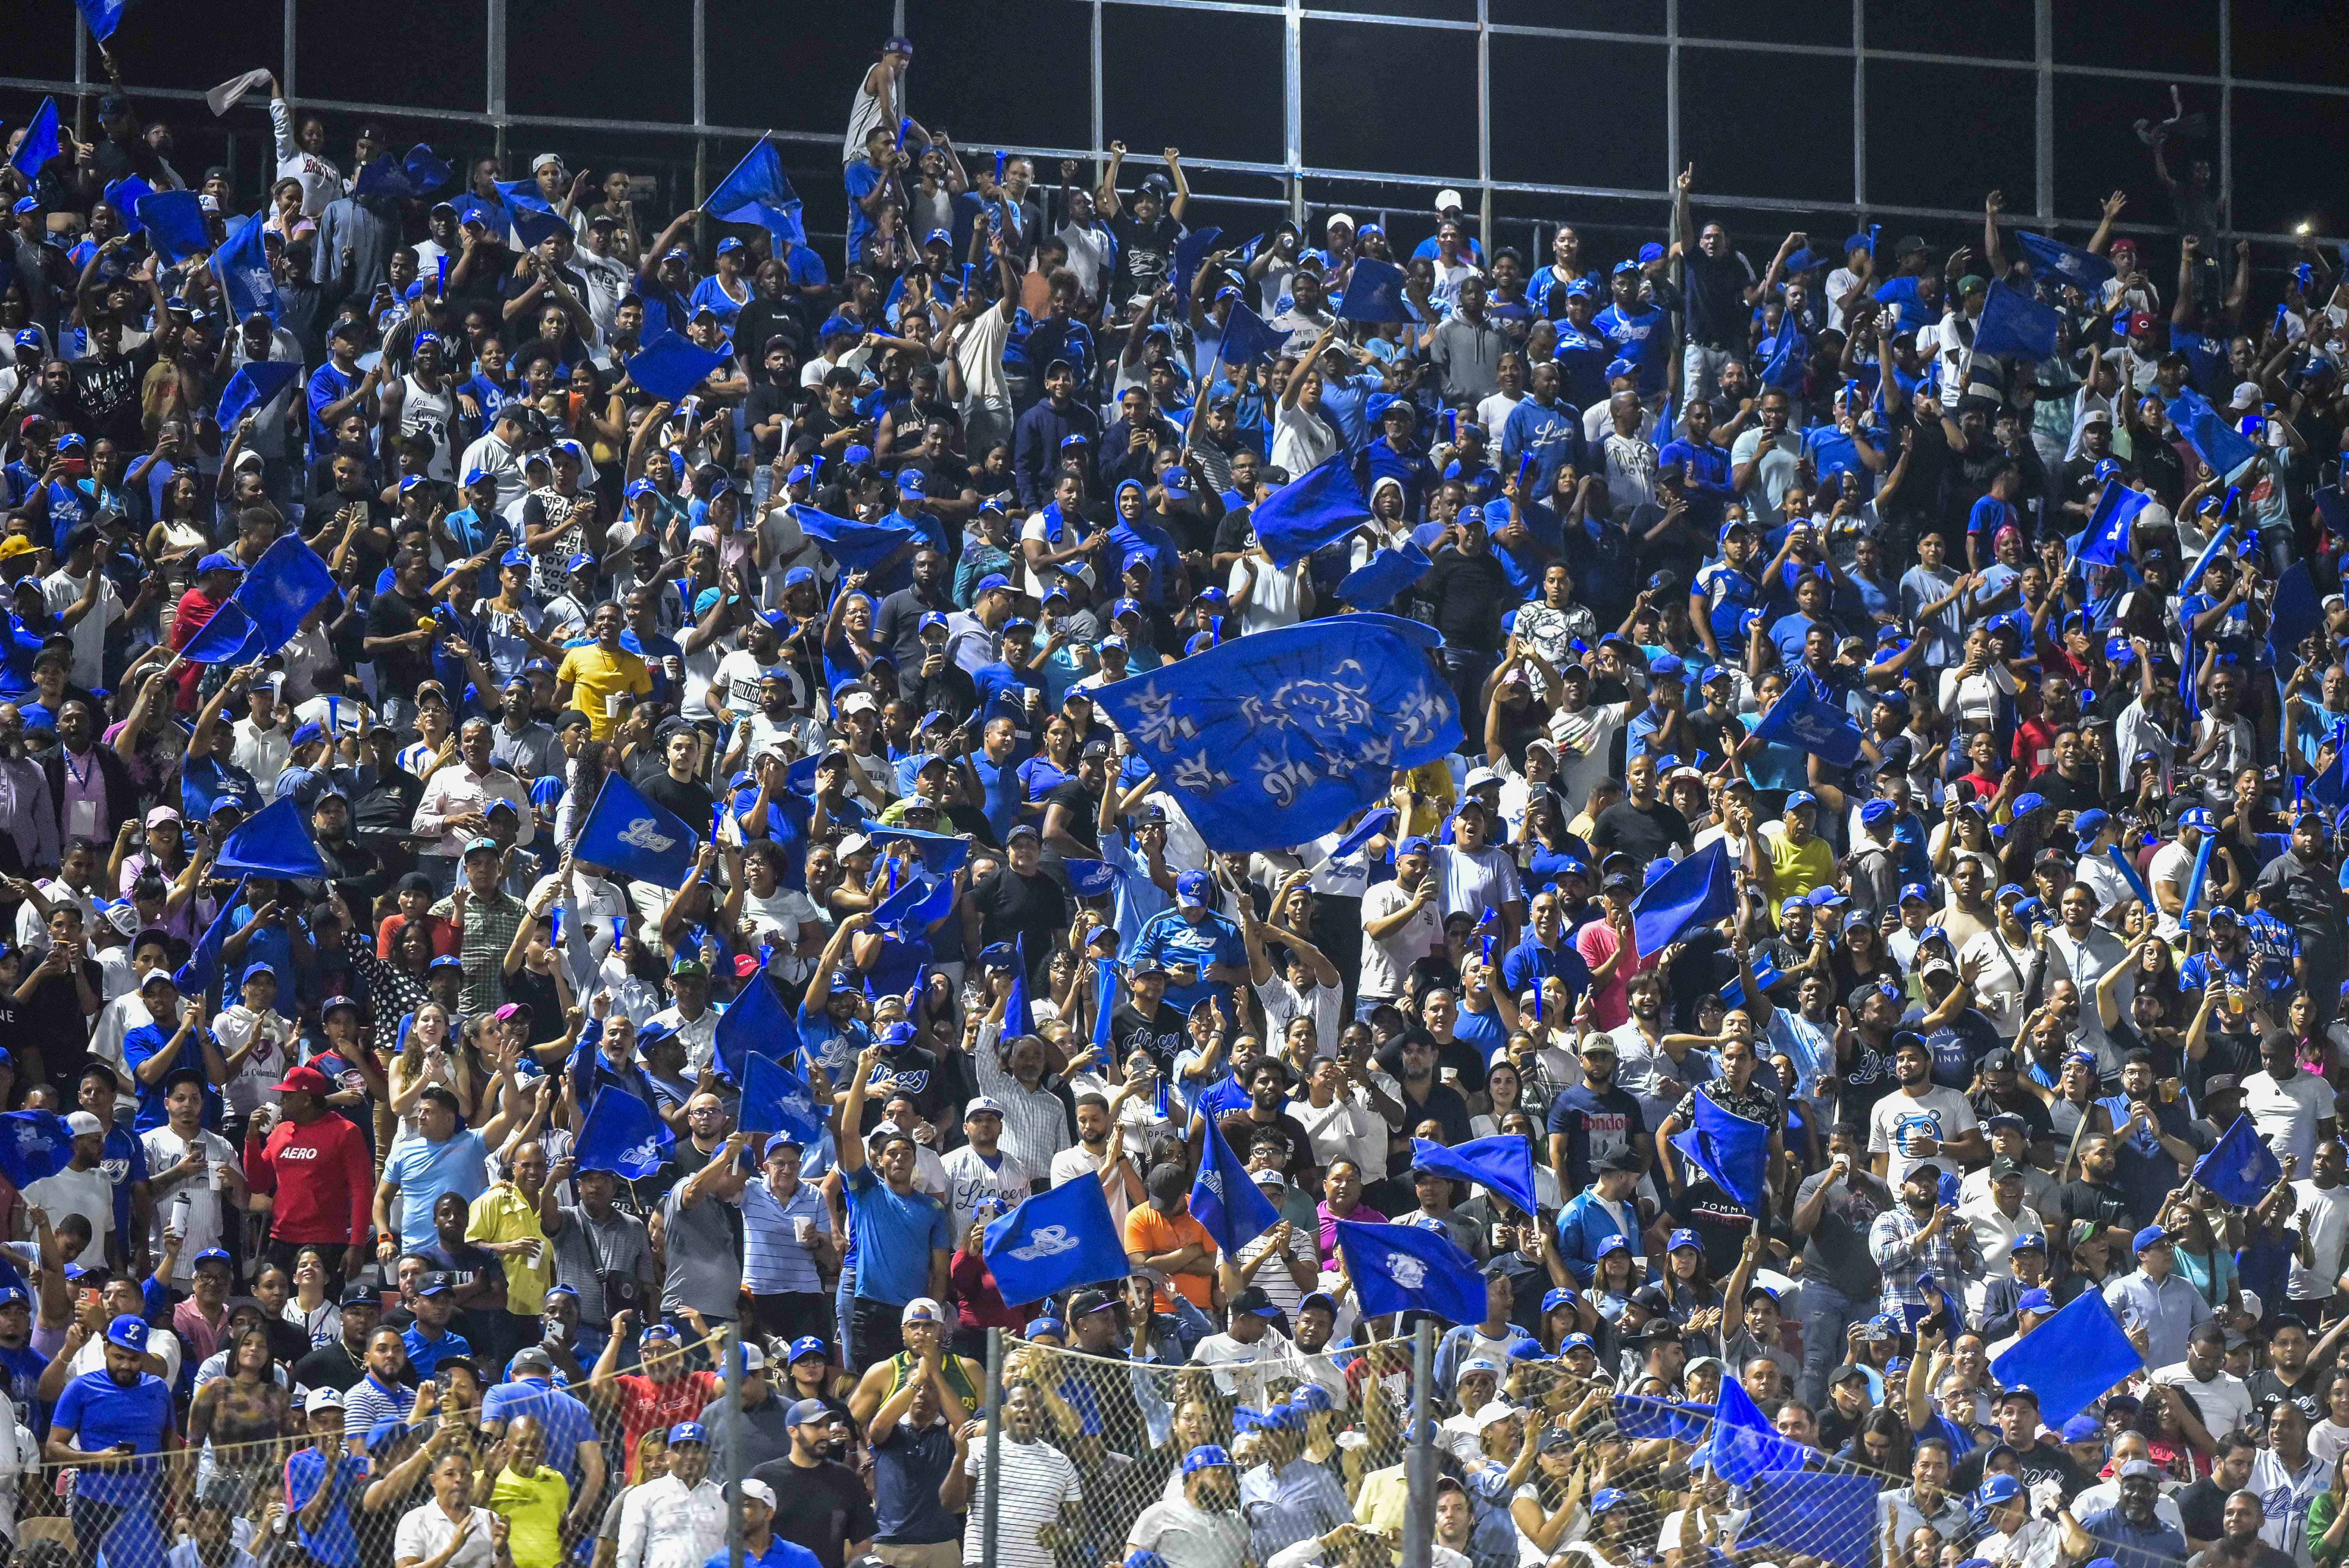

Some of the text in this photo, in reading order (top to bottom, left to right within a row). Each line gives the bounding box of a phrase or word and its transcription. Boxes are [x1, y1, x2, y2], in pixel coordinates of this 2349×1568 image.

[200, 197, 209, 206] L
[21, 331, 31, 340] L
[79, 361, 134, 399] AMIRI
[69, 433, 78, 442] L
[638, 478, 648, 489] L
[1178, 476, 1187, 487] L
[516, 551, 524, 559] L
[1134, 552, 1143, 562] L
[1652, 575, 1660, 588] L
[1123, 598, 1134, 609] L
[927, 611, 938, 622] L
[733, 681, 761, 703] HOLLIST
[1097, 743, 1105, 752] NY
[1150, 806, 1160, 816] L
[1189, 883, 1199, 894] L
[1907, 883, 1918, 894] L
[1852, 911, 1862, 921] L
[2029, 905, 2039, 919] L
[833, 975, 843, 984] L
[241, 1068, 278, 1078] La Colonial
[866, 1063, 929, 1093] Licey
[280, 1147, 317, 1159] AERO
[955, 1177, 1025, 1210] Licey
[612, 1202, 653, 1215] PRAD
[1702, 1201, 1746, 1214] TOMMY
[1428, 1219, 1439, 1228] L
[1612, 1235, 1623, 1245] L
[1681, 1230, 1692, 1240] L
[2023, 1233, 2034, 1245] L
[10, 1288, 19, 1298] LA
[1556, 1287, 1567, 1298] L
[125, 1324, 139, 1340] L
[801, 1336, 816, 1349] L
[322, 1390, 336, 1400] L
[1294, 1387, 1309, 1399] L
[680, 1424, 693, 1437] L
[1552, 1428, 1562, 1437] L
[1985, 1482, 1995, 1498] L
